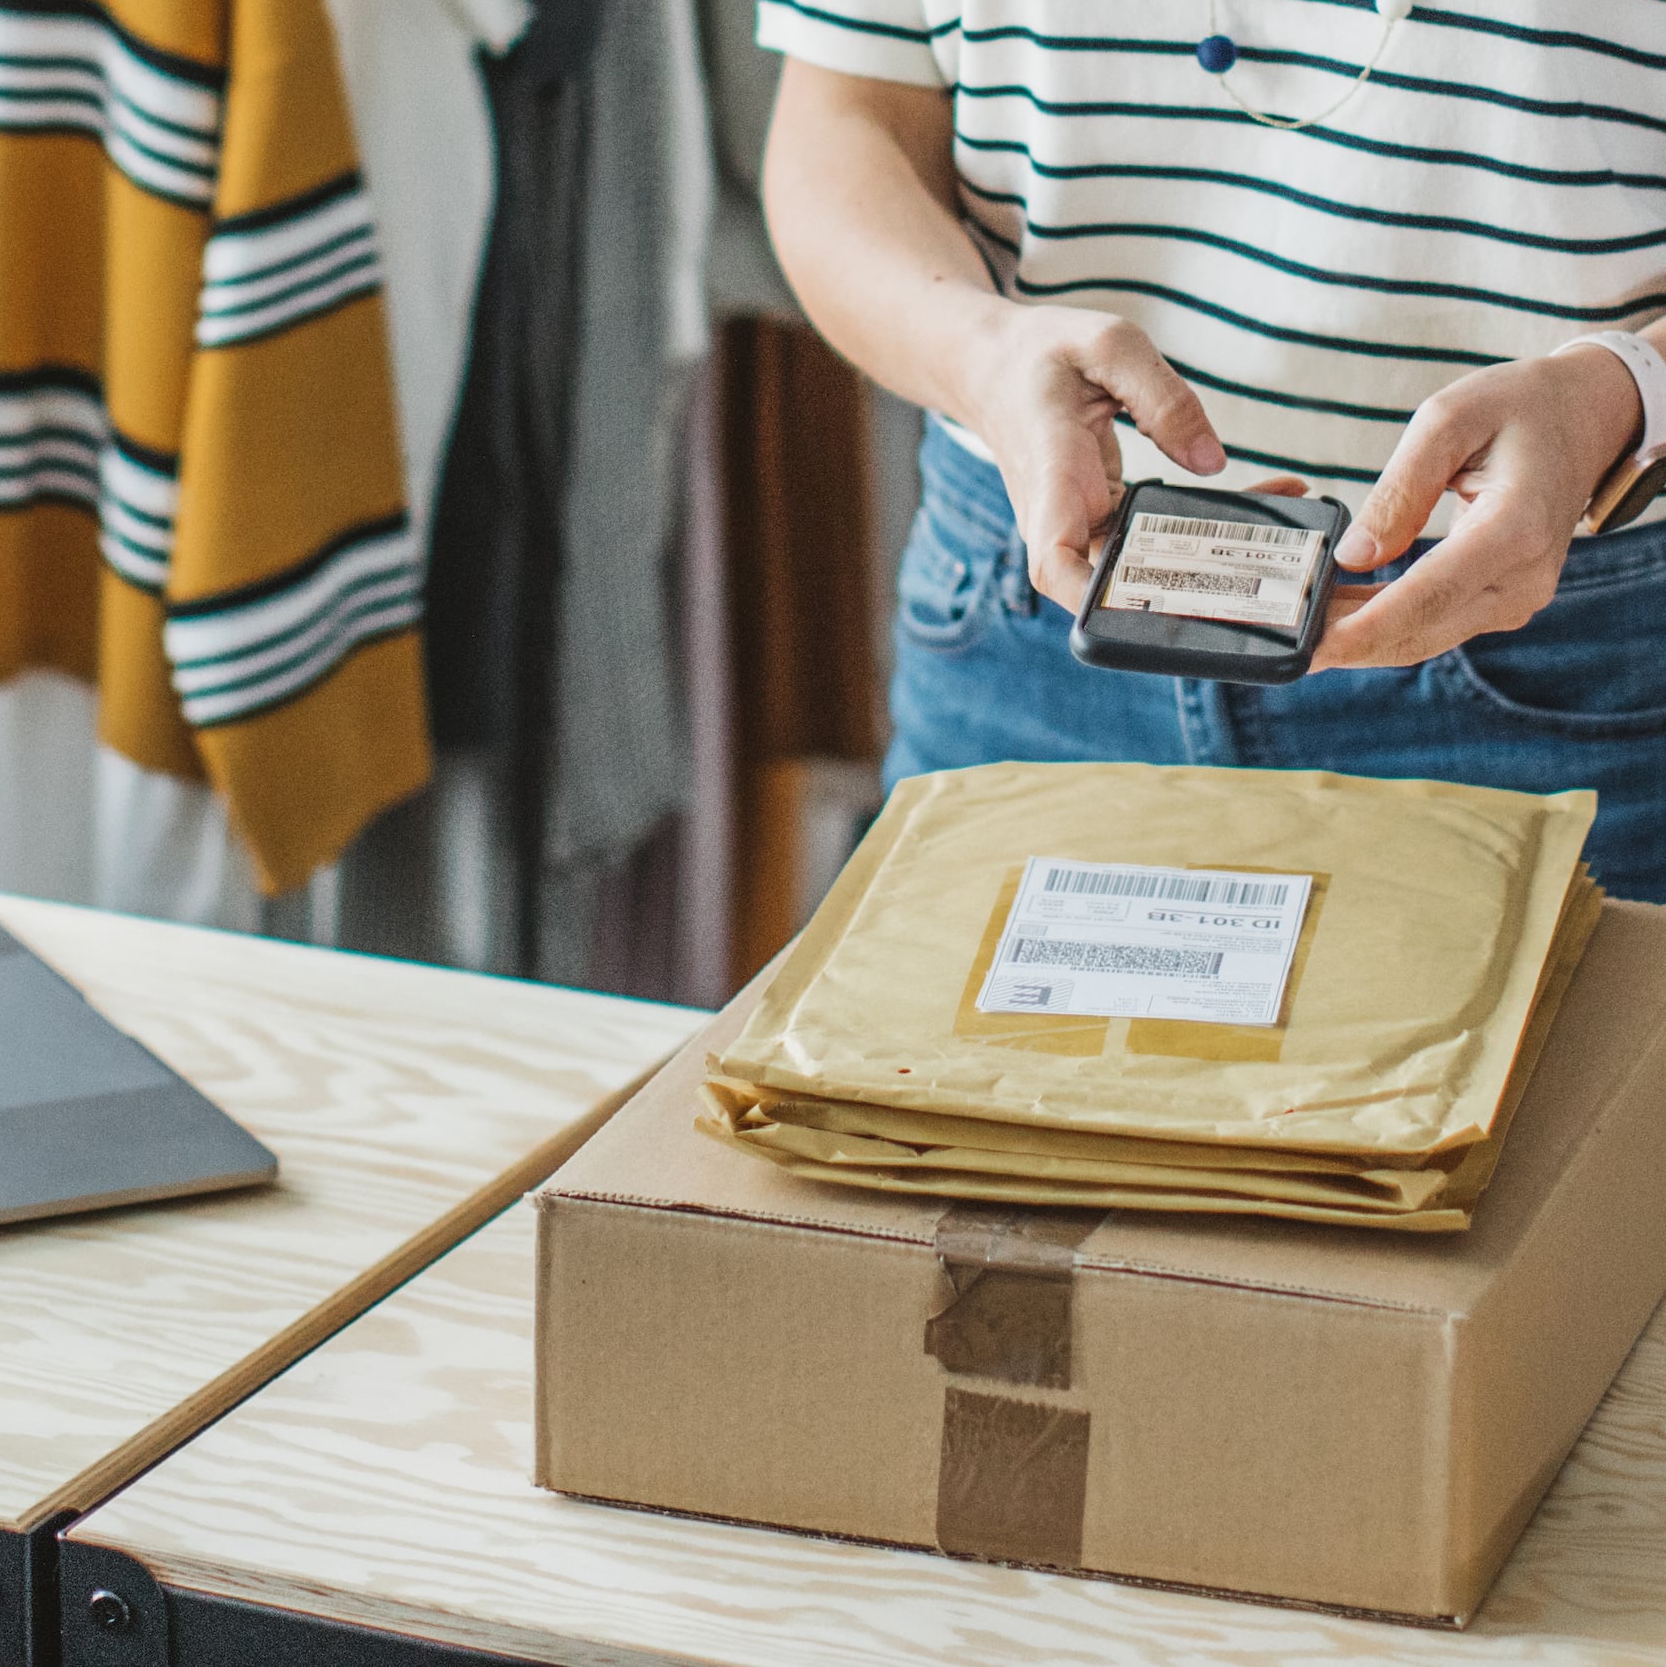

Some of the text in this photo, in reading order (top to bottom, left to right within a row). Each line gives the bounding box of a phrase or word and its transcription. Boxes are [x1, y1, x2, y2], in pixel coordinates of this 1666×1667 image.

[1281, 555, 1302, 563] ID
[1147, 911, 1281, 929] ID 301-3B
